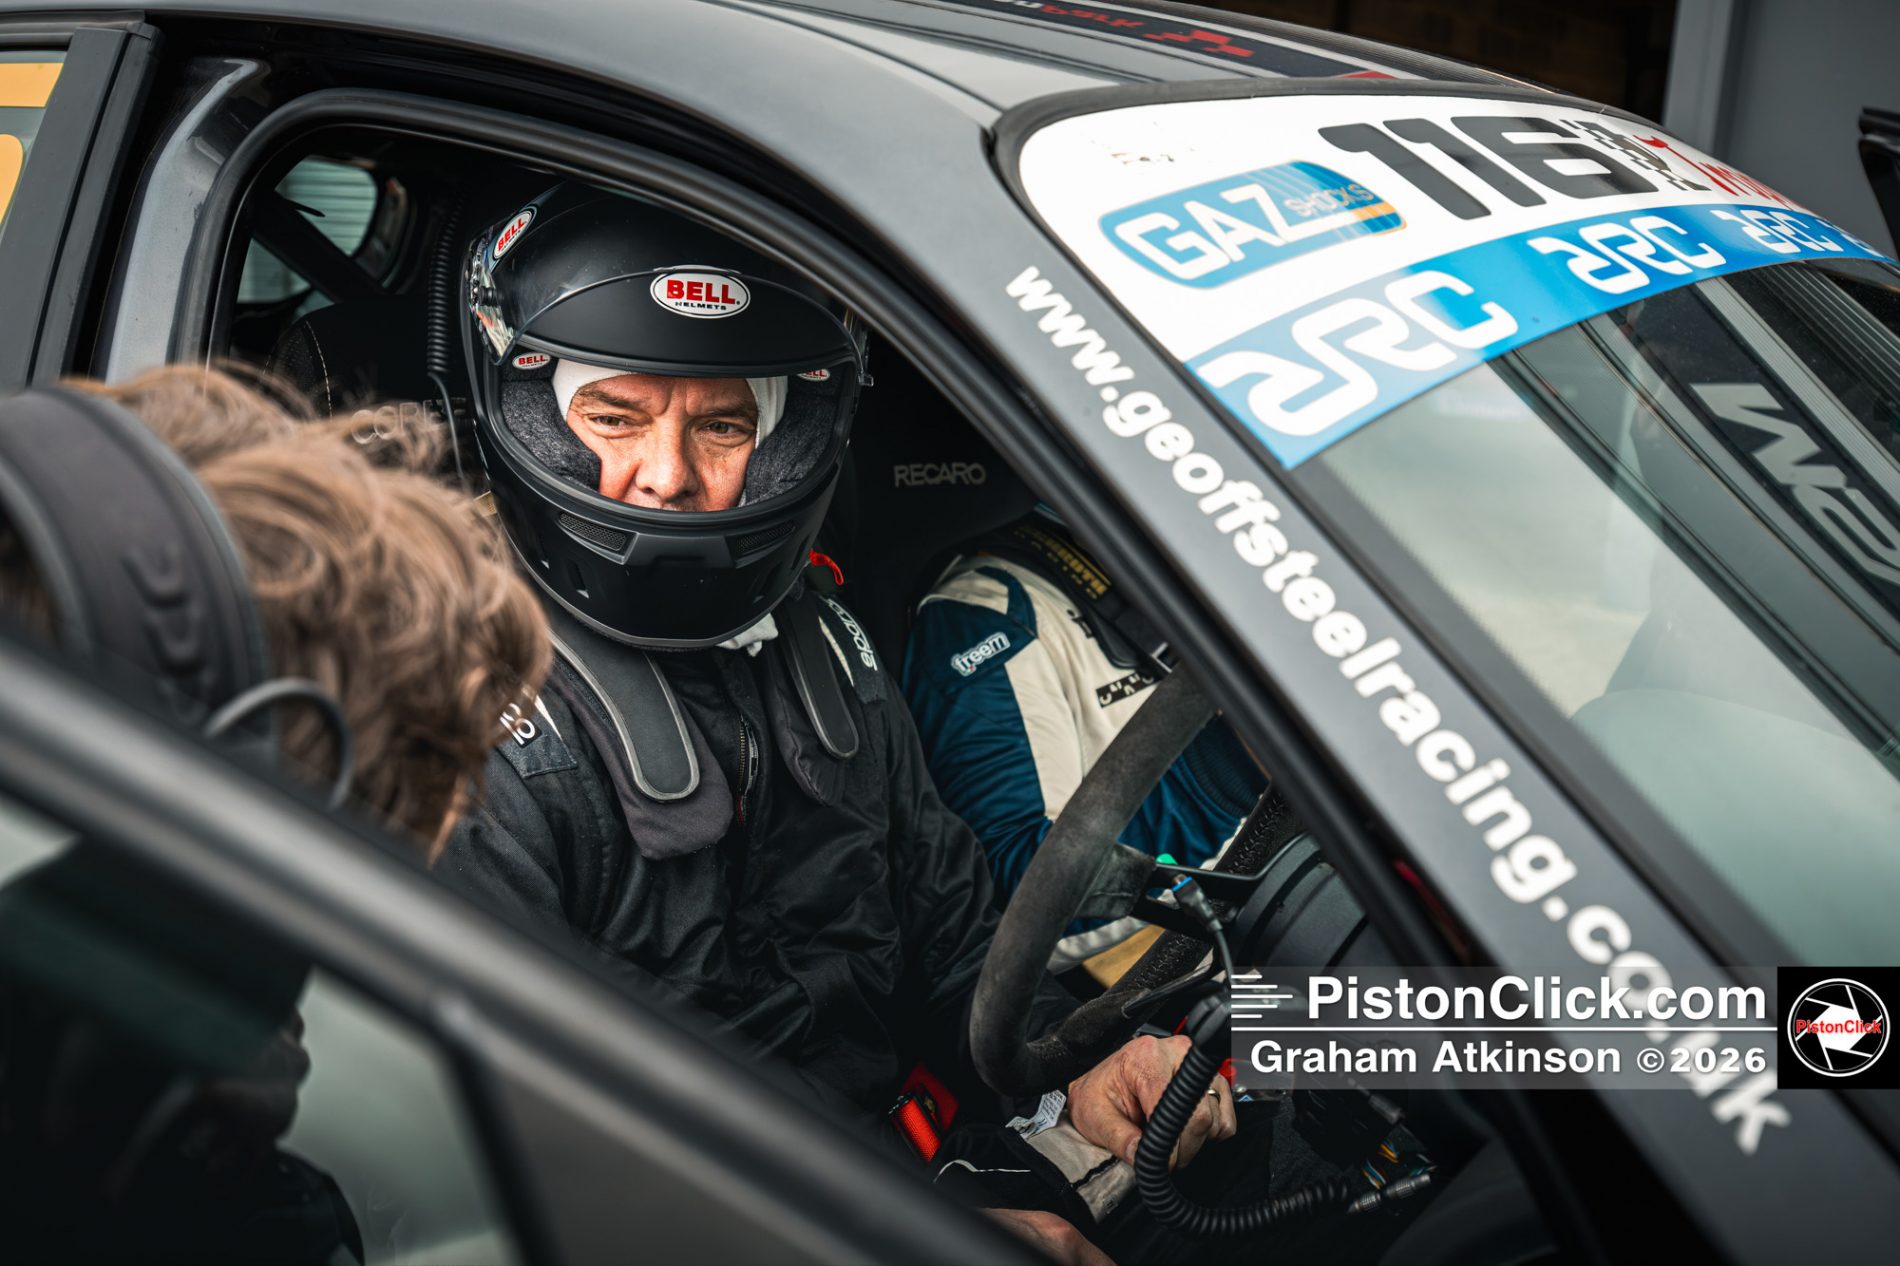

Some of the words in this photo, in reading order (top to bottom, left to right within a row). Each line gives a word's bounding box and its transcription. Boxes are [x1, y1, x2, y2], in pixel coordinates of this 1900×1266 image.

[1317, 116, 1660, 220] 116
[1283, 182, 1376, 216] SHOCKS
[498, 218, 525, 252] BELL
[1114, 184, 1305, 282] GAZ
[666, 280, 736, 305] BELL
[674, 301, 727, 311] HELMETS
[518, 354, 546, 366] BELL
[893, 462, 987, 488] RECARO
[952, 632, 1009, 675] freem
